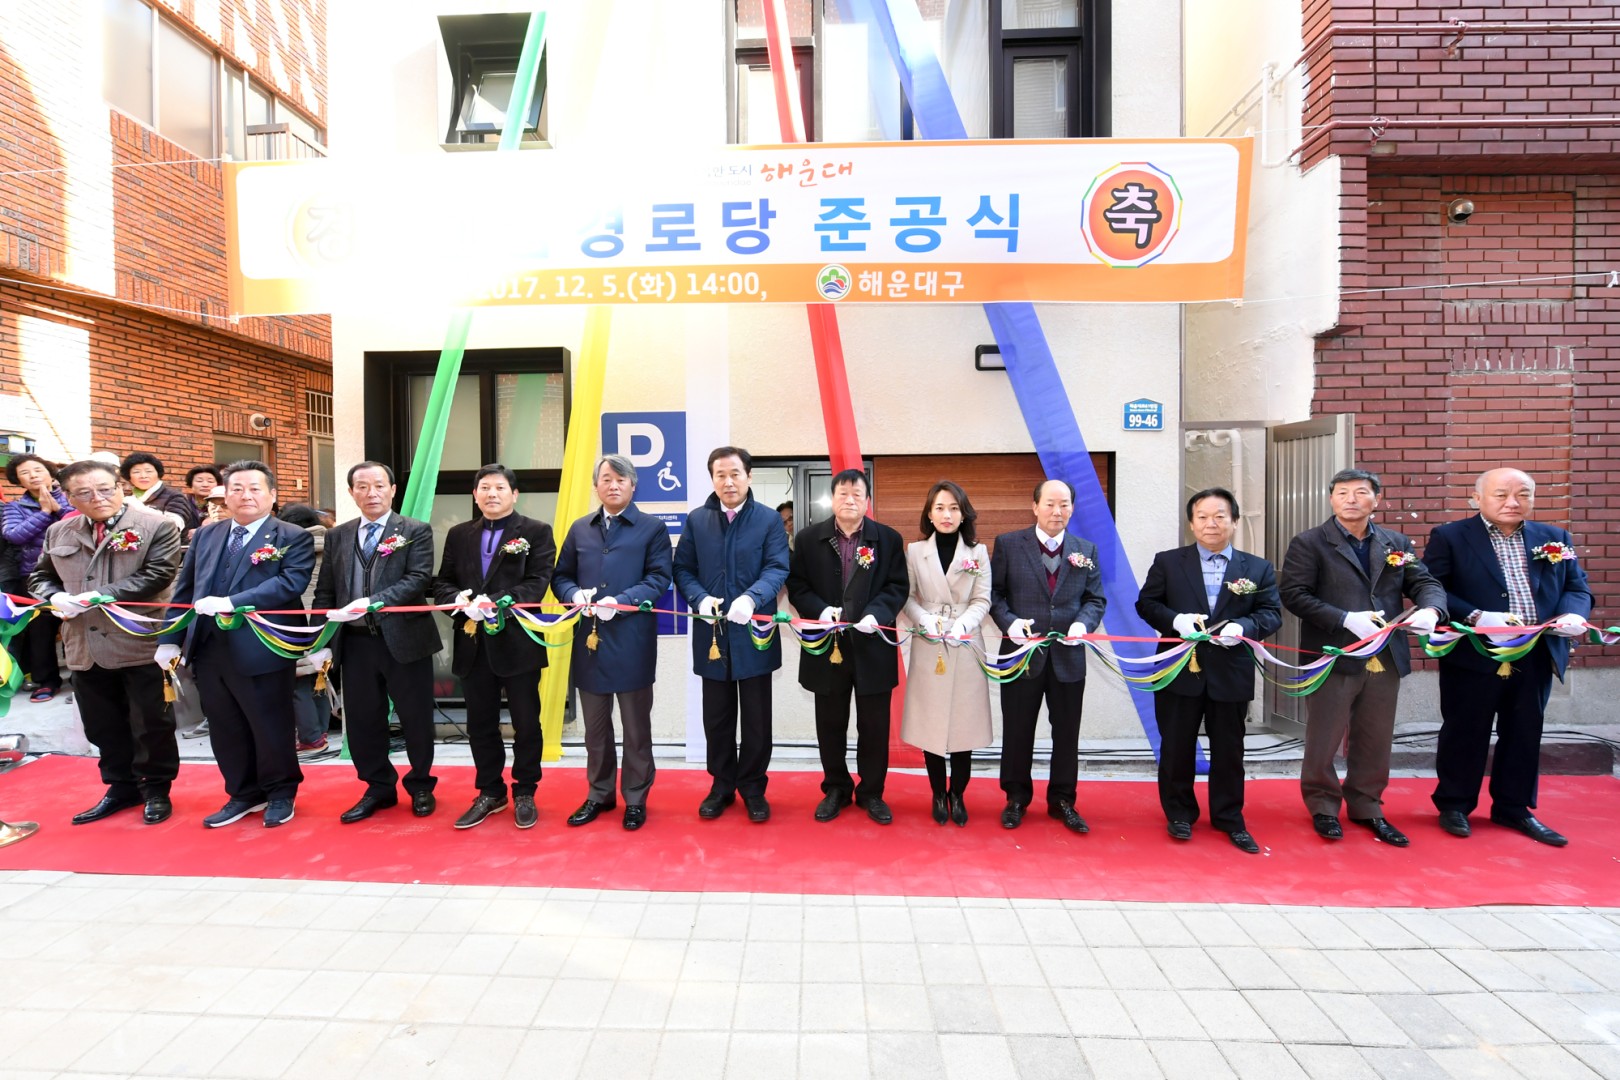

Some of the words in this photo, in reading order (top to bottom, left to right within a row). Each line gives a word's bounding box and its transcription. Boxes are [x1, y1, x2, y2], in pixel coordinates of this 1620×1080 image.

[728, 163, 752, 177] 도시
[760, 159, 853, 187] 해운대
[526, 198, 777, 259] 경로당
[814, 193, 1020, 254] 준공식
[1104, 182, 1161, 249] 축
[555, 274, 593, 299] 12.
[687, 272, 767, 301] 14:00,
[858, 270, 965, 298] 해운대구
[1128, 414, 1158, 427] 99-46
[617, 423, 665, 468] P
